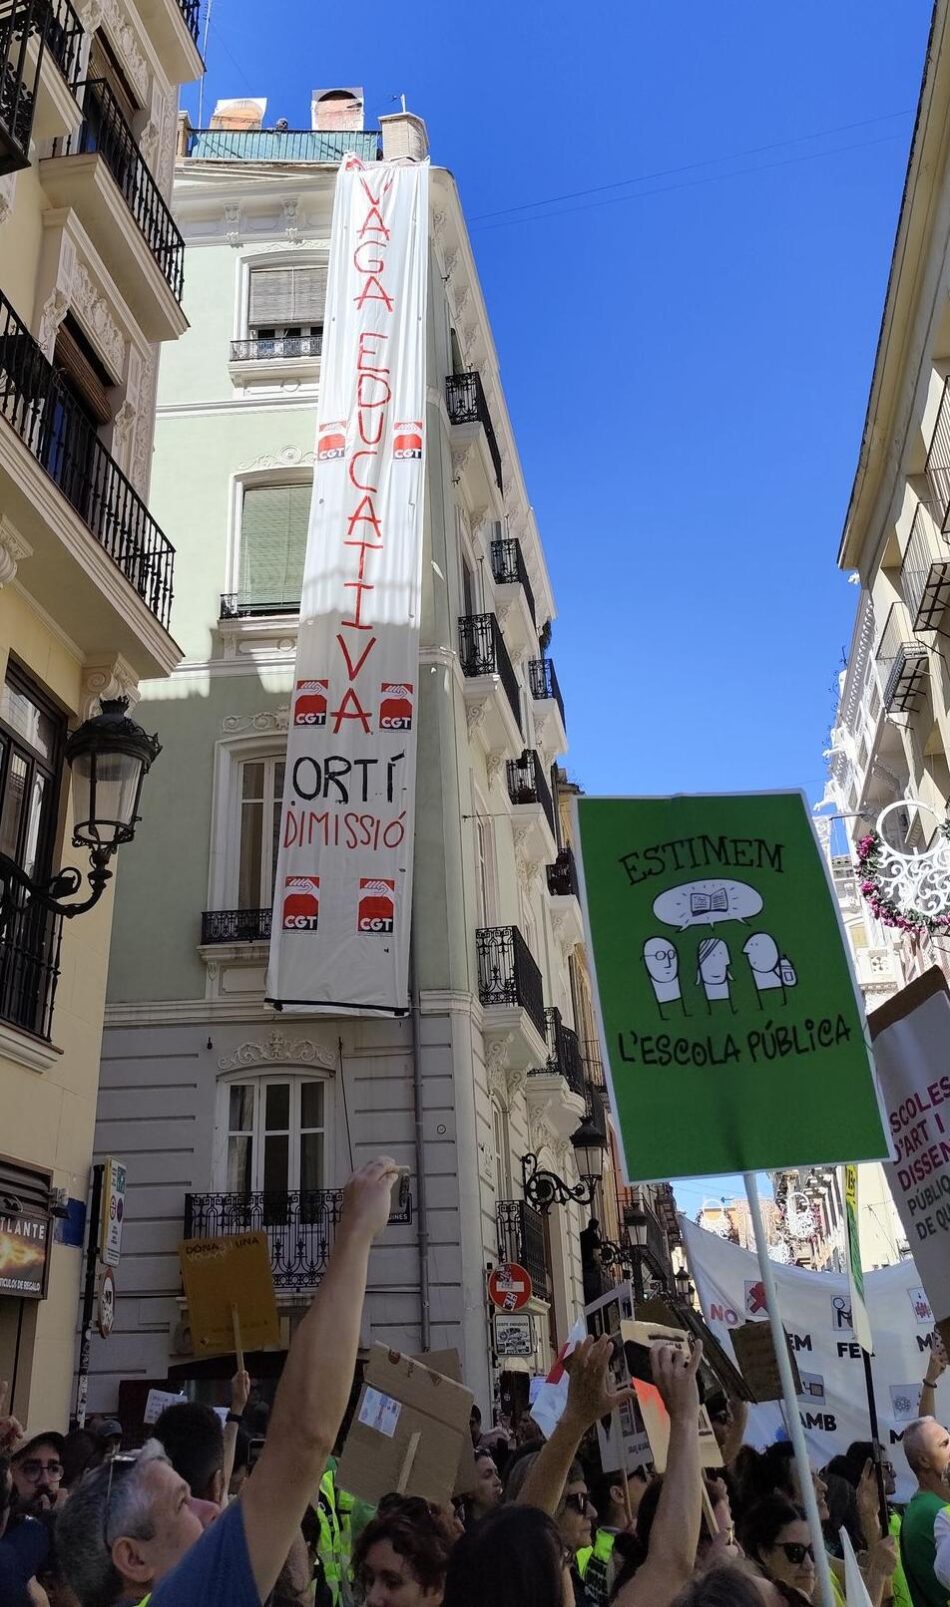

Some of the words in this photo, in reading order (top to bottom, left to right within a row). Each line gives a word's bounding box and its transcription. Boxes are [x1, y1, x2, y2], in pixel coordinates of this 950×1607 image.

[353, 175, 395, 313] VAGA
[319, 447, 345, 460] CGT
[394, 448, 422, 459] CGT
[330, 333, 392, 734] EDUCATIVA
[295, 712, 326, 726] CGT
[380, 716, 412, 729] CGT
[292, 749, 405, 804] ORTÍ
[283, 810, 407, 851] DIMISSIÓ
[618, 835, 786, 886] ESTIMEM
[284, 915, 318, 930] CGT
[359, 918, 393, 931] CGT
[618, 1030, 741, 1067] L'ESCOLA
[934, 1112, 945, 1135] I
[915, 1216, 937, 1240] DE
[710, 1303, 738, 1326] NO
